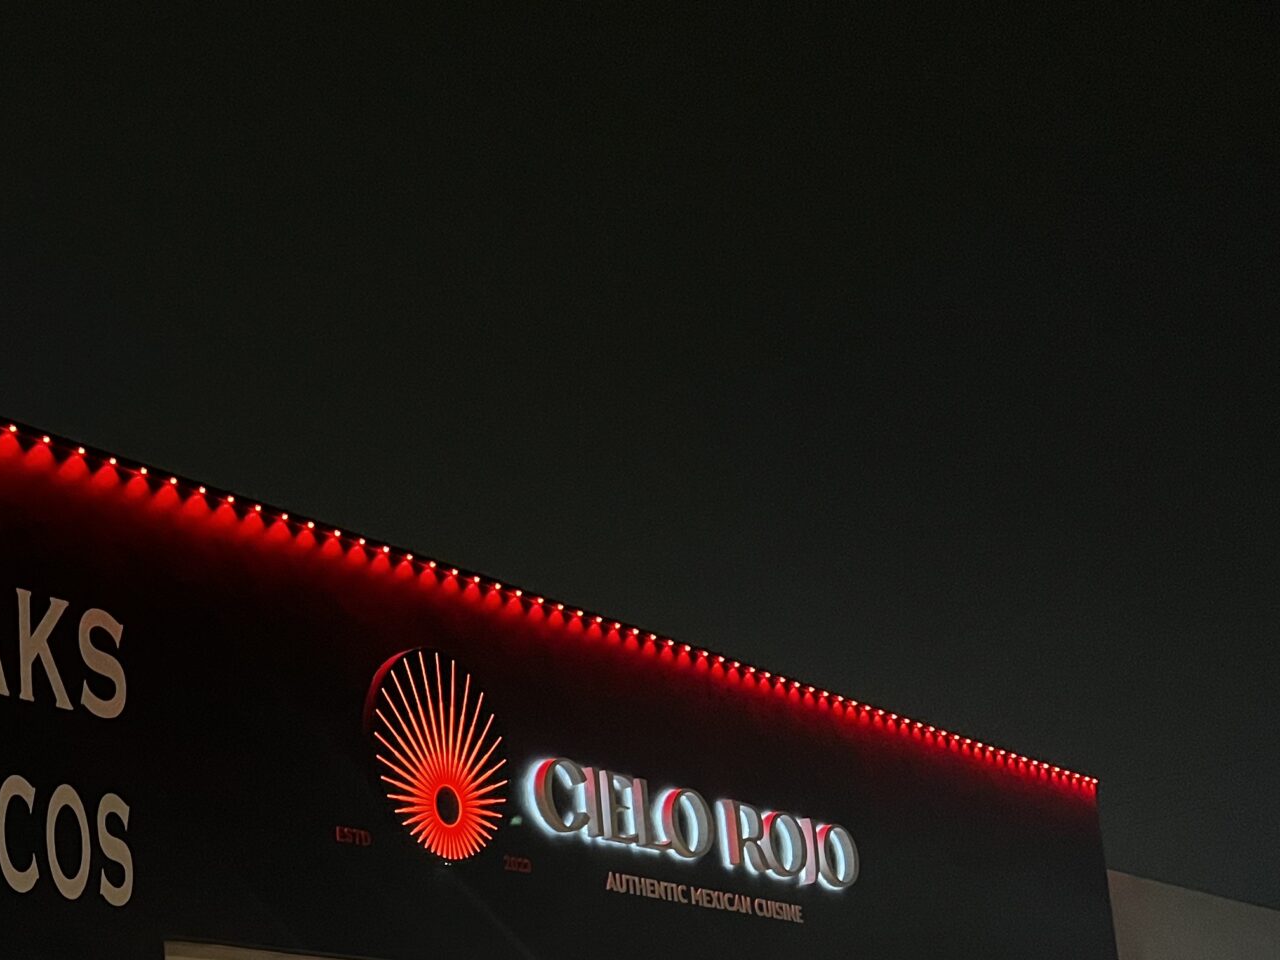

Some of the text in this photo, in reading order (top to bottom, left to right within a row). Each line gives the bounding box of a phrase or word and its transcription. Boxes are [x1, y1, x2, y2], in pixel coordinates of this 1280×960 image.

[534, 758, 860, 888] CIELO ROJO
[606, 871, 804, 923] AUTHENTIC MEXICAN CUISINE
